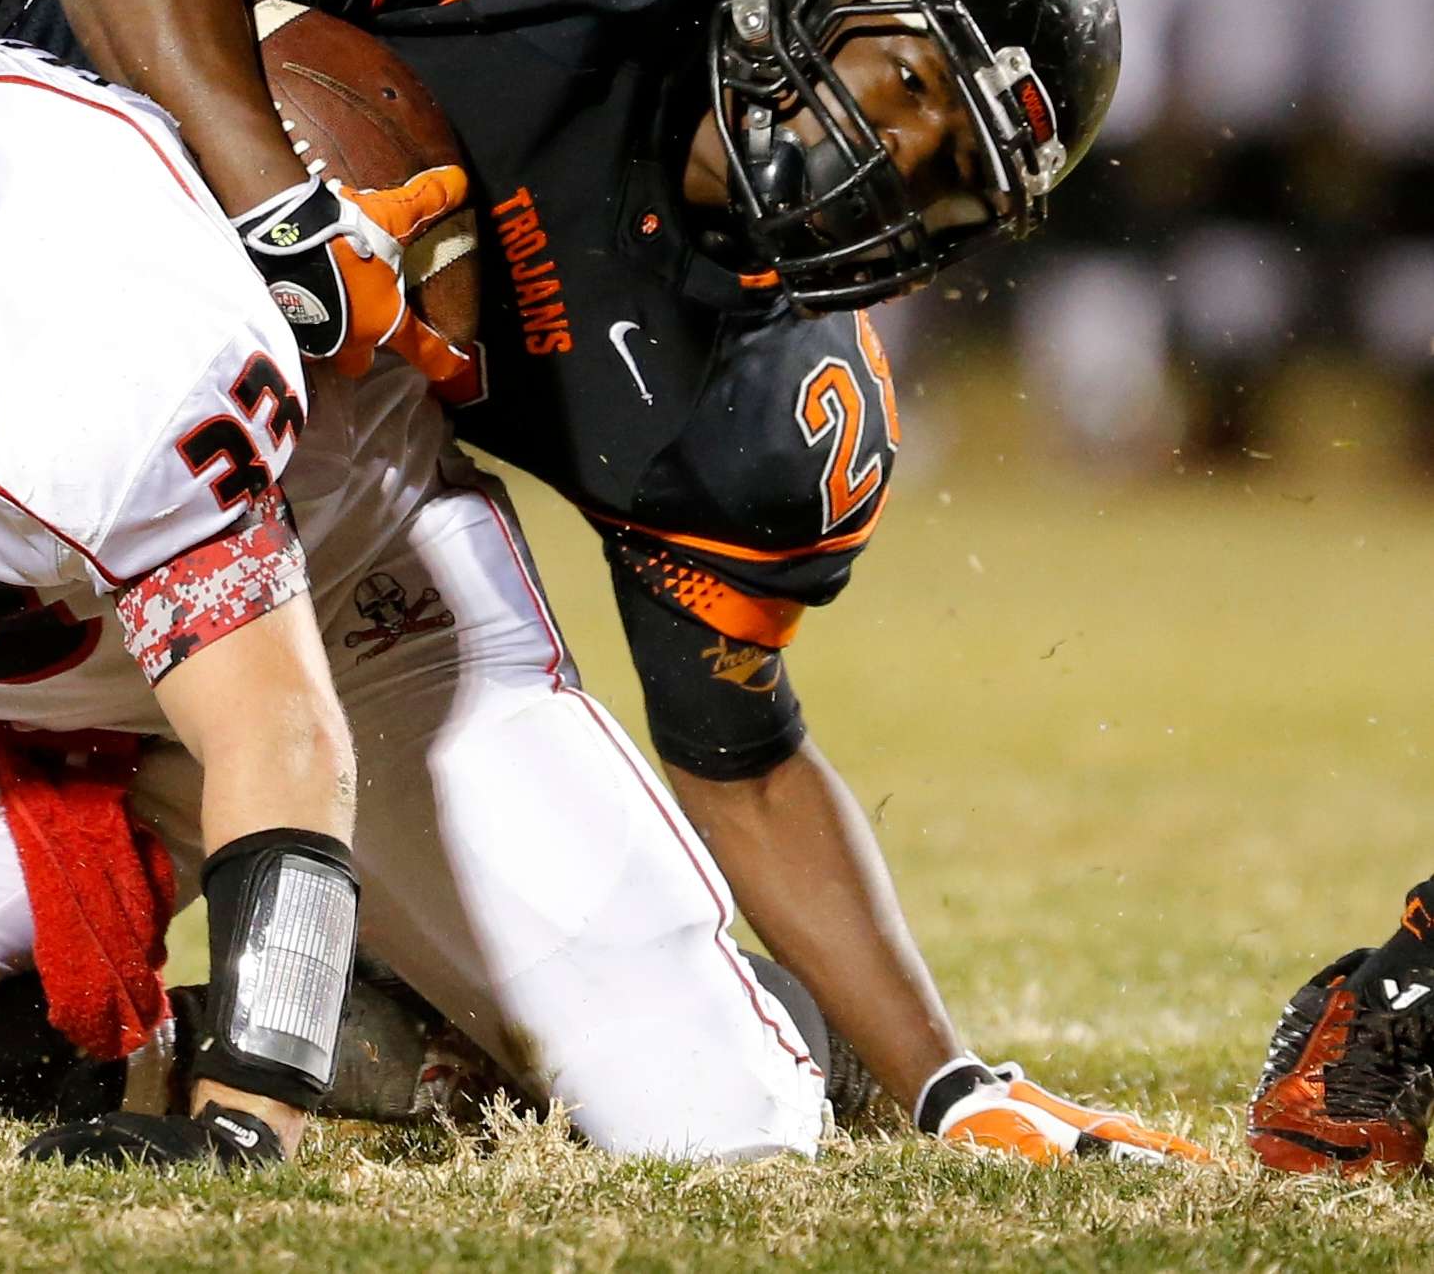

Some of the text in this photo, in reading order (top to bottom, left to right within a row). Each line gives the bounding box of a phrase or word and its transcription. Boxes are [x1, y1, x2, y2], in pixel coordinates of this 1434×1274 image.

[490, 184, 574, 356] TROJANS
[175, 349, 307, 513] 33
[795, 309, 902, 534] 2
